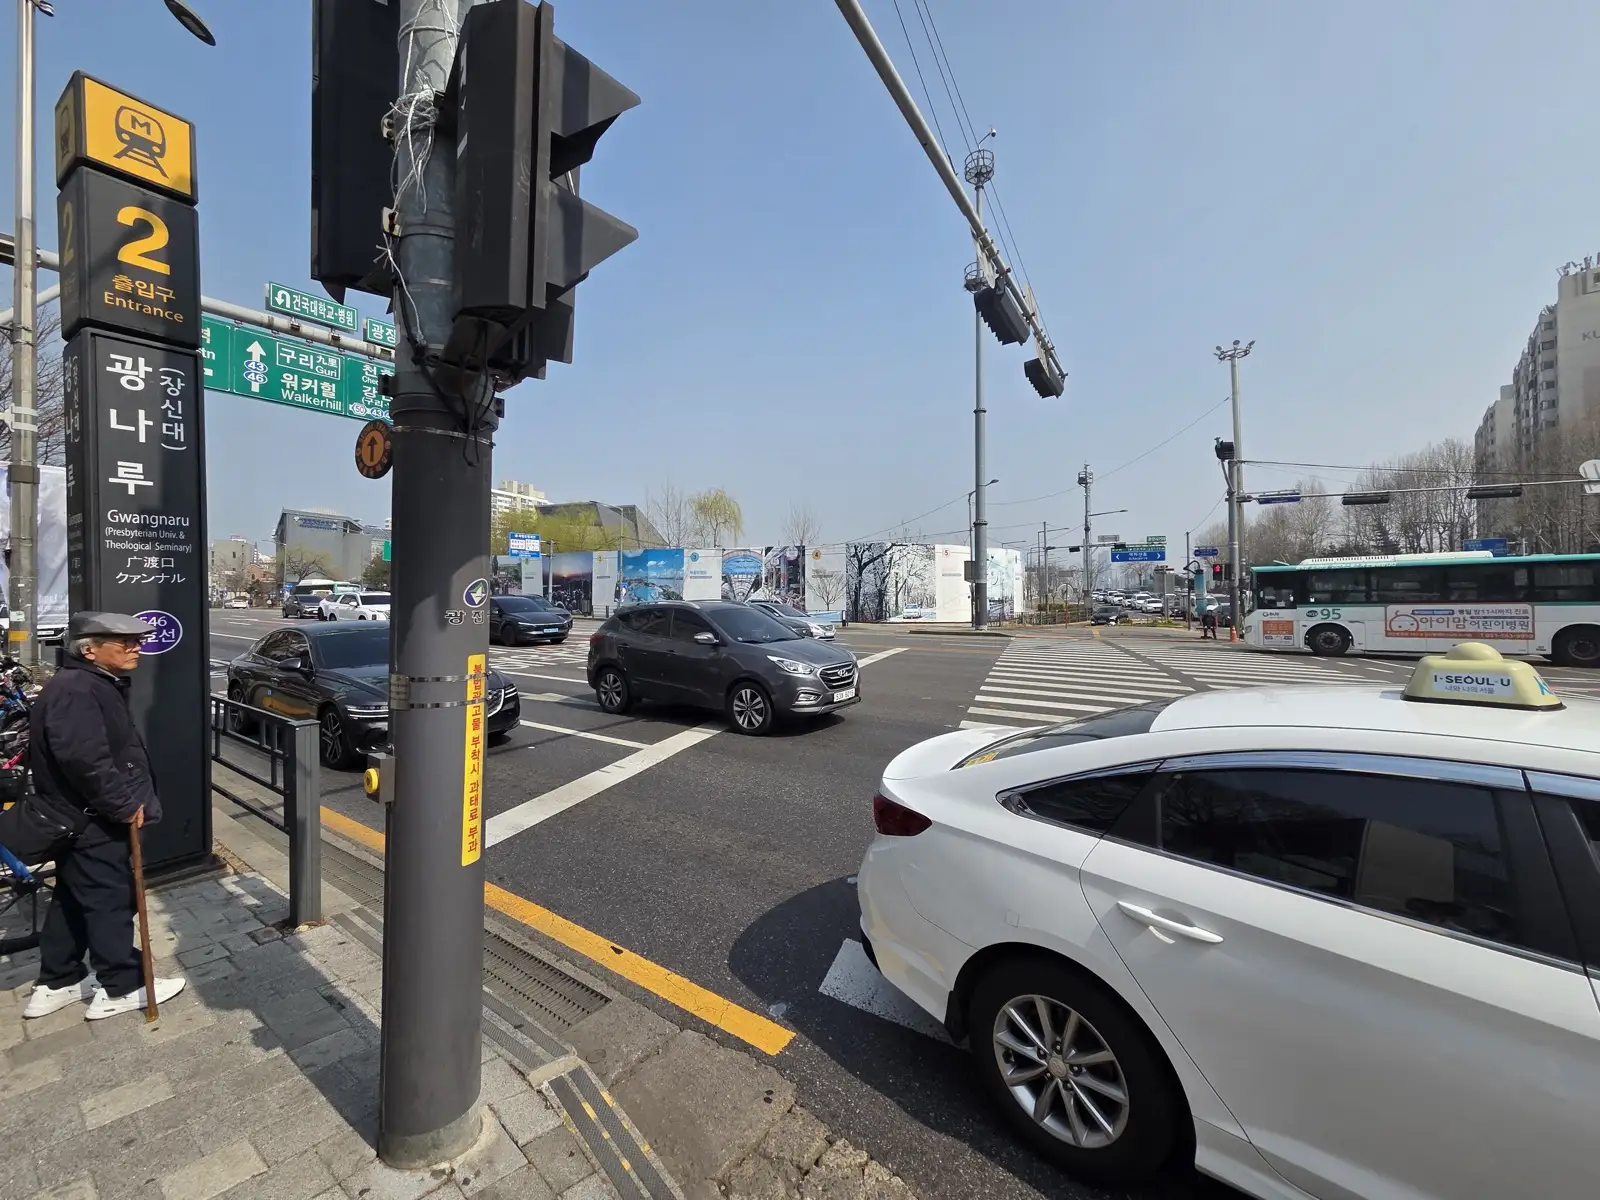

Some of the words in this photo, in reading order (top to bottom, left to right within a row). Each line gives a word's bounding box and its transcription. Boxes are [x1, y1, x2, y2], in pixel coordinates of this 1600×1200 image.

[117, 205, 171, 276] 2
[112, 274, 176, 303] 출입구
[104, 291, 184, 323] Entrance
[248, 361, 265, 372] 43
[280, 348, 314, 370] 구리
[247, 372, 264, 382] 46
[316, 366, 337, 378] Guri
[281, 373, 336, 399] 워커힐
[159, 367, 187, 450] (장신대)
[281, 389, 342, 411] Walkerhill
[371, 409, 382, 417] 43
[106, 353, 154, 495] 광나루
[107, 509, 190, 528] Gwangnaru
[105, 526, 157, 539] (Presbyterian
[159, 530, 178, 539] Univ.
[179, 531, 185, 540] &
[105, 540, 152, 552] Theological
[155, 542, 192, 554] Seminary)
[126, 555, 175, 569] 广渡口
[444, 609, 489, 626] 광진
[1320, 608, 1342, 620] 95
[1420, 616, 1468, 630] 아이맘
[1469, 620, 1530, 631] 어린이병원
[1480, 687, 1496, 695] 서울
[469, 779, 480, 822] 과태료
[467, 825, 478, 853] 부과
